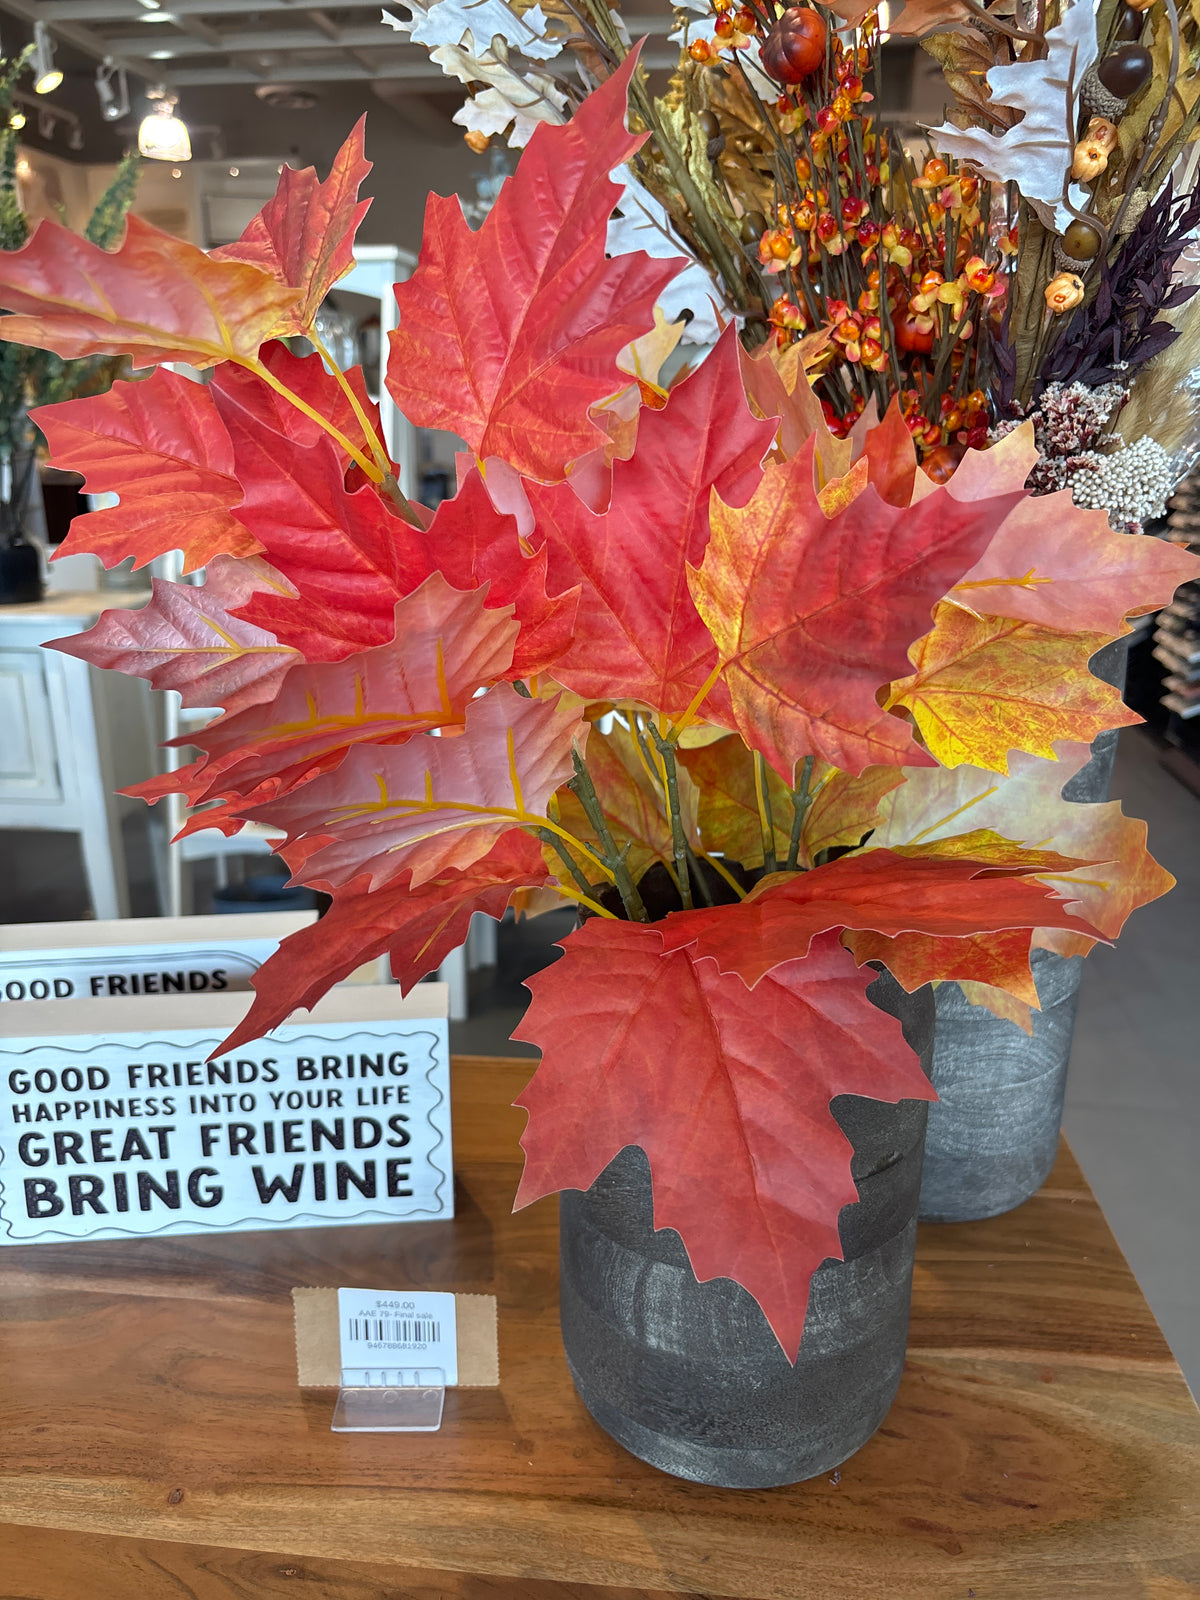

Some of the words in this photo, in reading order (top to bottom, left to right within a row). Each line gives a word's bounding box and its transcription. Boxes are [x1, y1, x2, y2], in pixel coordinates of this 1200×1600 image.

[0, 979, 74, 1000] OOD
[90, 969, 228, 996] FRIENDS
[8, 1066, 110, 1094] GOOD
[128, 1058, 280, 1089] FRIENDS
[297, 1052, 408, 1081] BRING
[12, 1097, 176, 1124] HAPPINESS
[190, 1093, 257, 1114] INTO
[270, 1088, 343, 1110] YOUR
[357, 1085, 410, 1106] LIFE
[18, 1126, 176, 1167] GREAT
[201, 1114, 412, 1157] FRIENDS
[24, 1167, 224, 1219] BRING
[252, 1158, 414, 1204] WINE
[376, 1301, 415, 1309] $449.00
[367, 1342, 428, 1350] 946788681920
